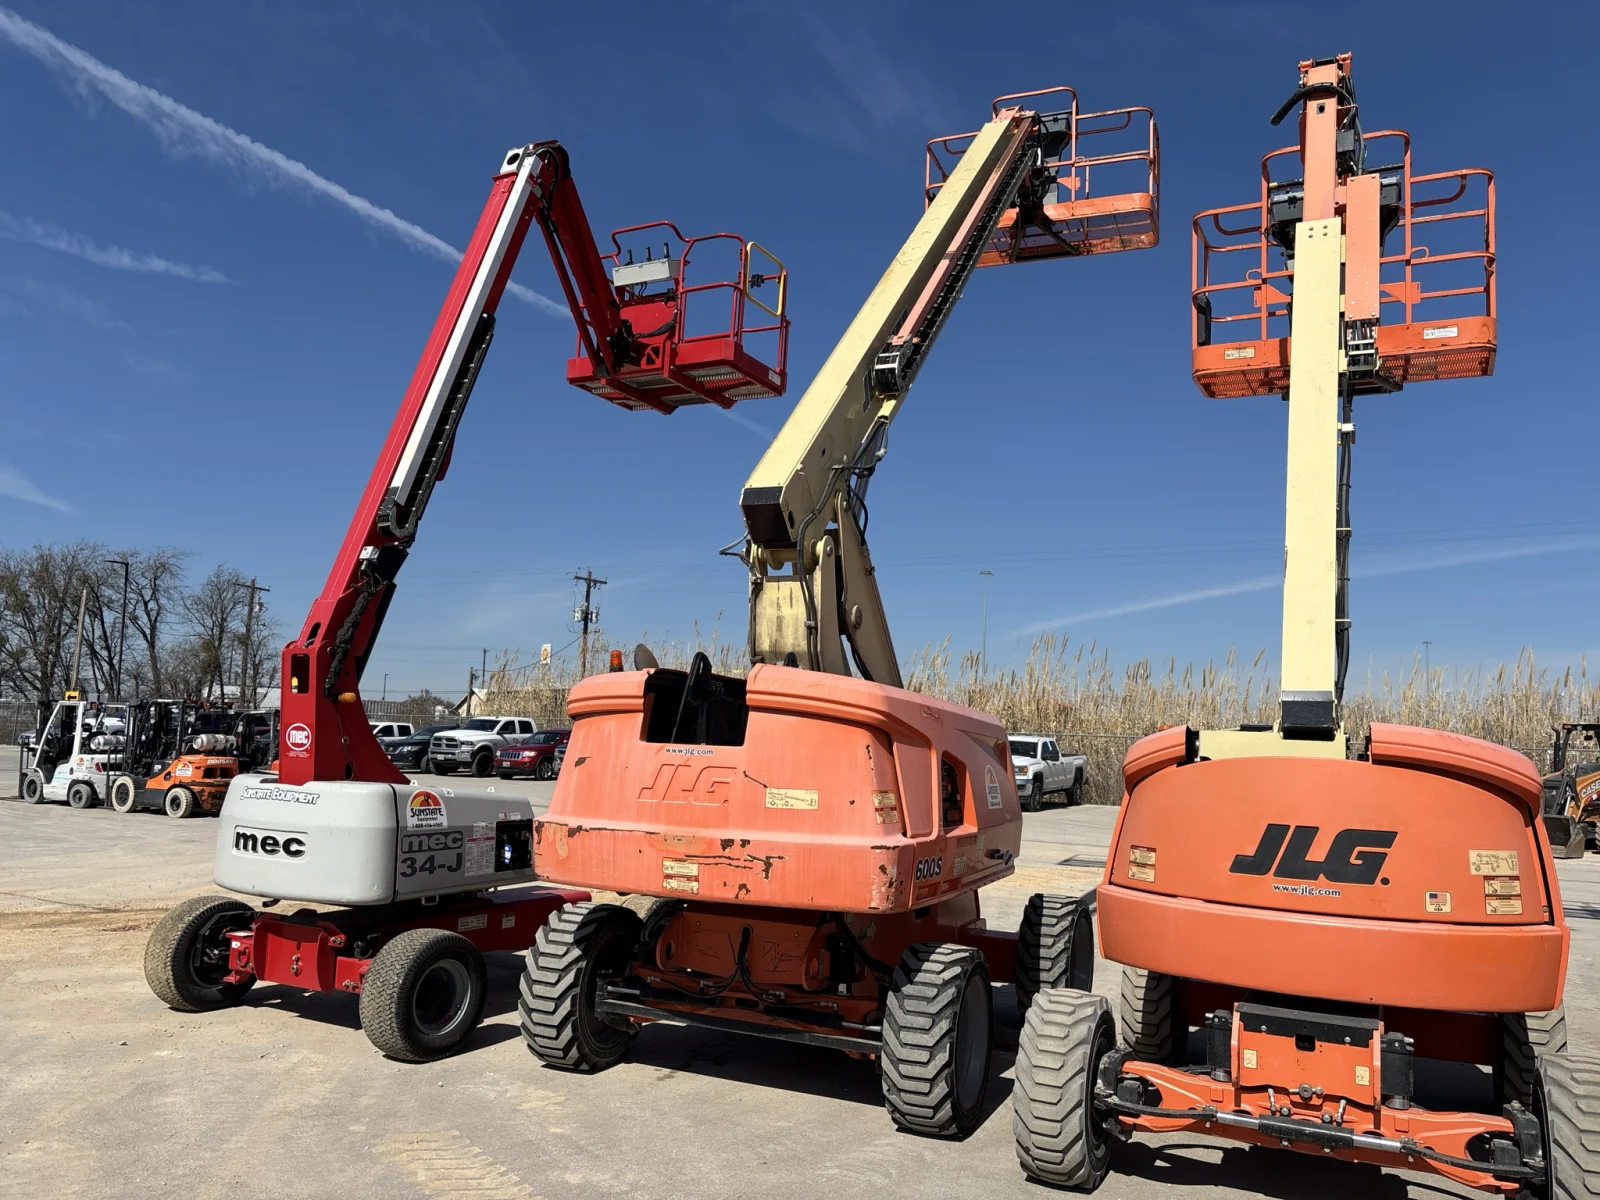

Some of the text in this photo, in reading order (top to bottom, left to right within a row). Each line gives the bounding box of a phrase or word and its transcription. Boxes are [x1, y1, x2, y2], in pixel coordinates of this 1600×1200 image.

[289, 729, 309, 744] mec
[1581, 779, 1600, 798] CASE
[410, 807, 444, 818] SUNSTATE
[234, 831, 306, 858] mec
[401, 832, 463, 853] mec
[400, 852, 463, 878] 34-J
[915, 856, 943, 881] 600S
[1272, 883, 1342, 897] www.jlg.com
